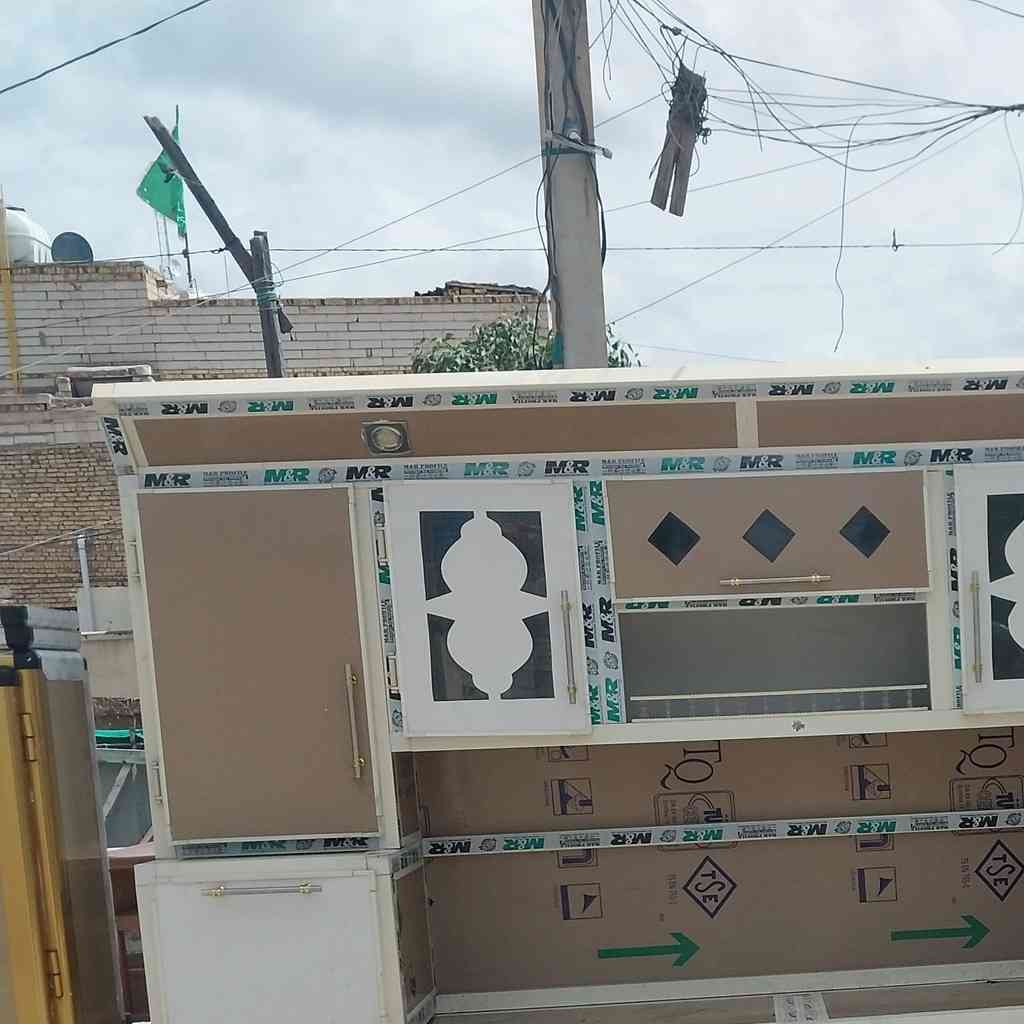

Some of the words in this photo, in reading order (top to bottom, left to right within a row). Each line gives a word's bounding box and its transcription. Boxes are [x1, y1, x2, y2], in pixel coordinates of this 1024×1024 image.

[740, 455, 784, 469] M&R
[853, 451, 896, 465] M&R
[930, 449, 973, 462] M&R
[464, 462, 509, 476] M&R
[544, 460, 590, 474] M&R
[660, 457, 705, 471] M&R
[144, 473, 191, 487] M&R
[264, 468, 310, 482] M&R
[345, 466, 391, 480] M&R
[590, 481, 605, 525] M&R
[599, 597, 616, 643] M&R
[606, 677, 621, 722] M&R
[857, 820, 896, 833] M&R
[959, 815, 998, 828] M&R
[683, 829, 723, 842] M&R
[788, 823, 827, 836] M&R
[504, 836, 544, 851] M&R
[610, 832, 652, 845] M&R
[429, 839, 471, 854] M&R
[986, 854, 1016, 887] TSE
[695, 870, 726, 903] TSE
